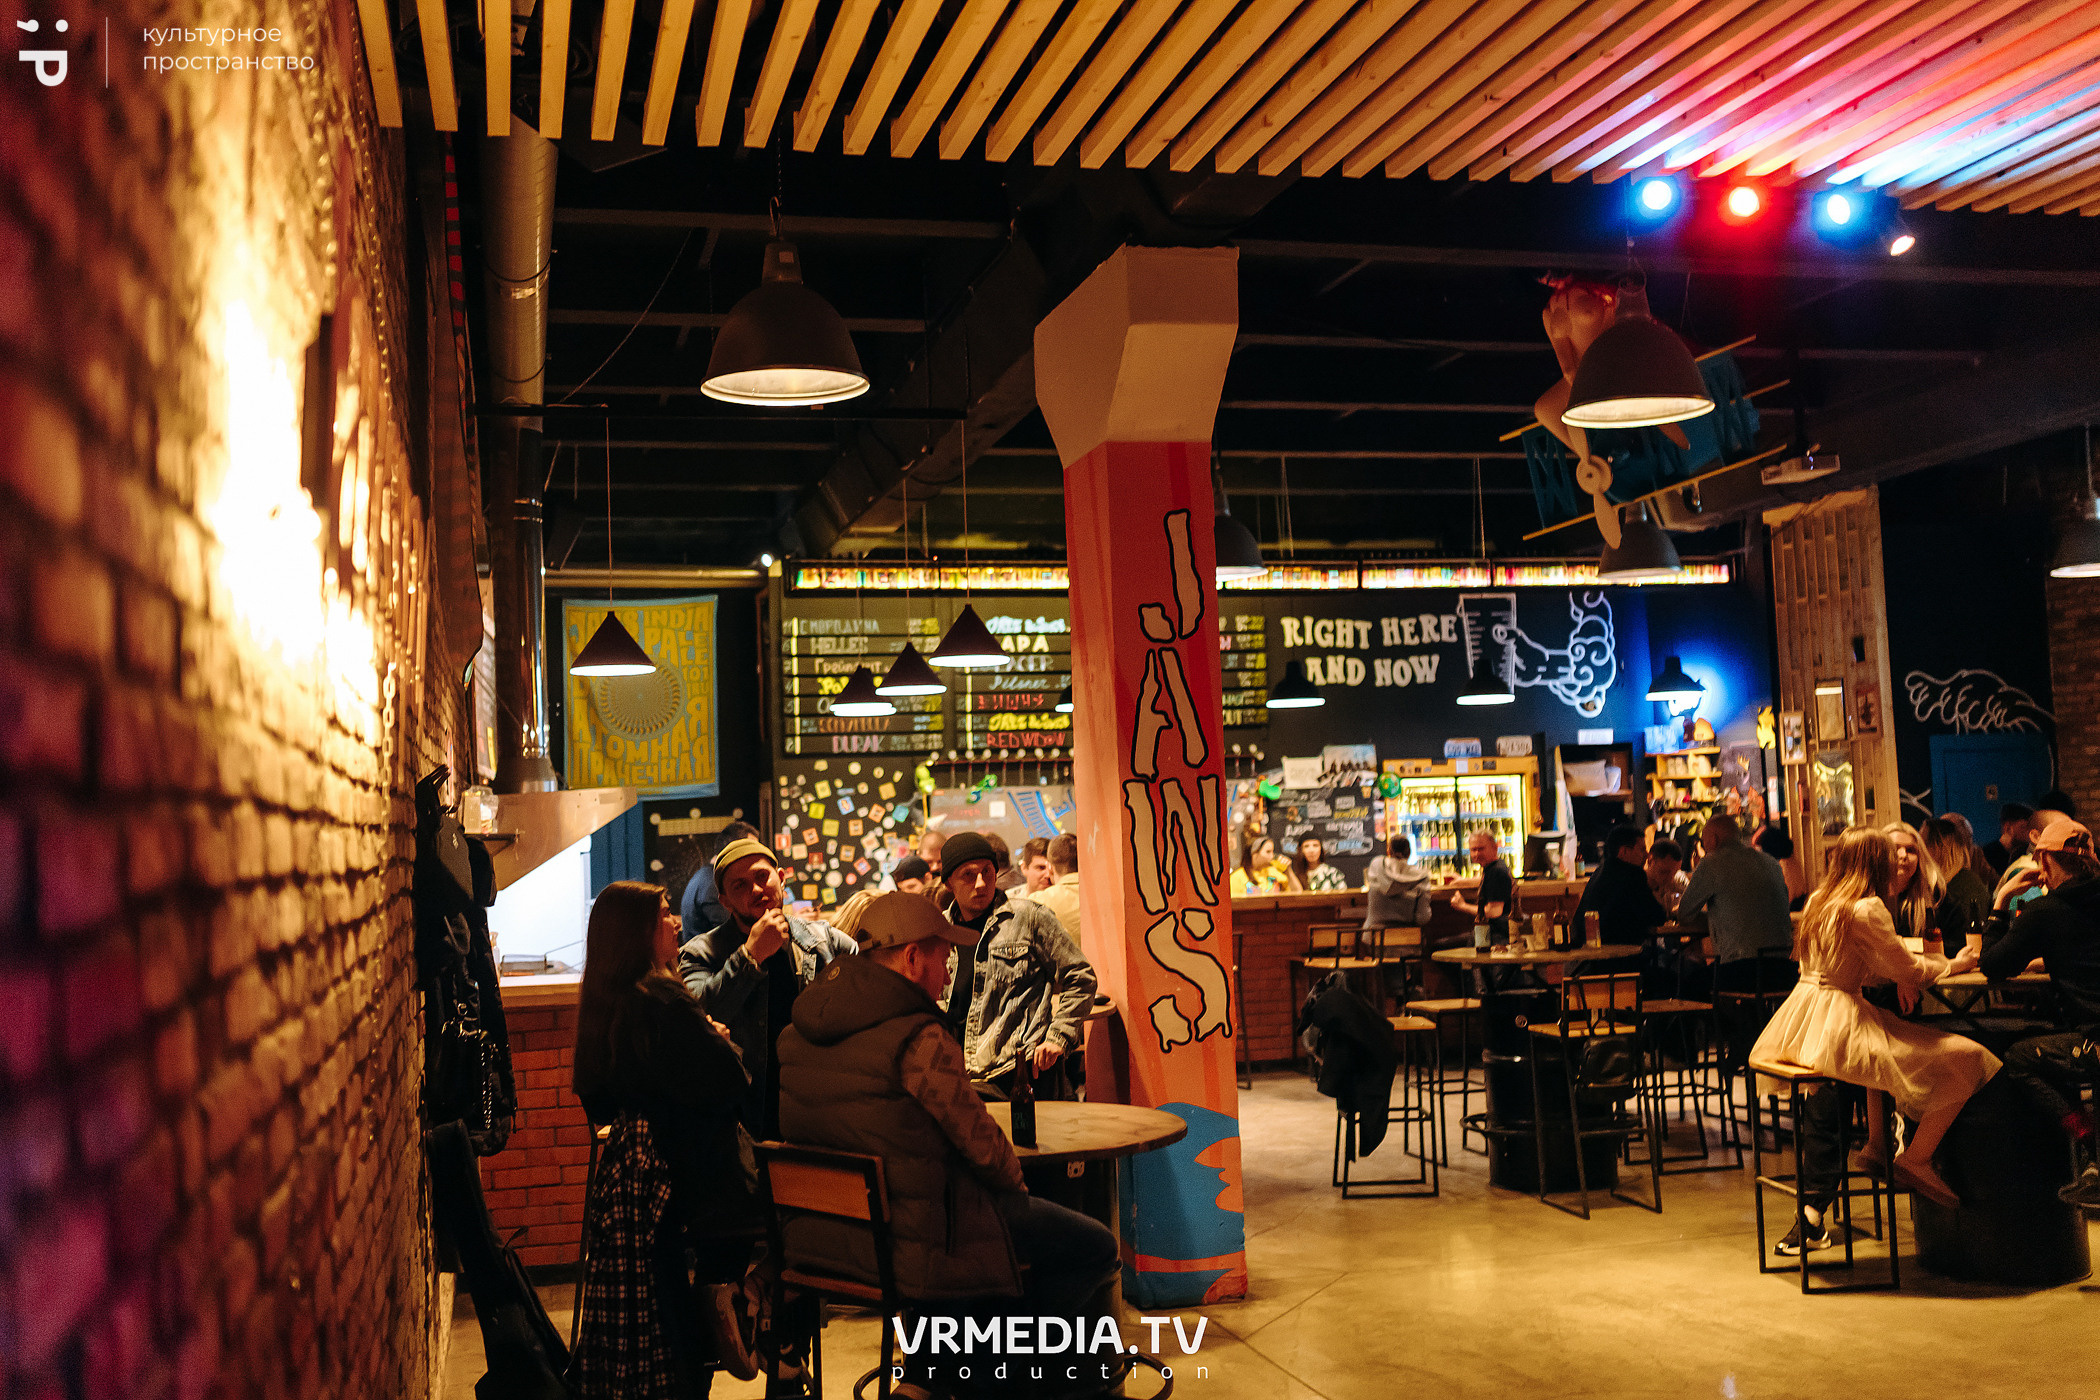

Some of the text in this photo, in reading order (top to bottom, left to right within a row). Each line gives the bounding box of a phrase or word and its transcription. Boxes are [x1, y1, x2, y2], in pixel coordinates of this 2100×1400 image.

[1281, 613, 1458, 649] RIGHT HERE
[1305, 654, 1440, 687] AND NOW
[986, 731, 1020, 749] RED
[573, 735, 711, 787] ПРАЧЕЧНАЯ
